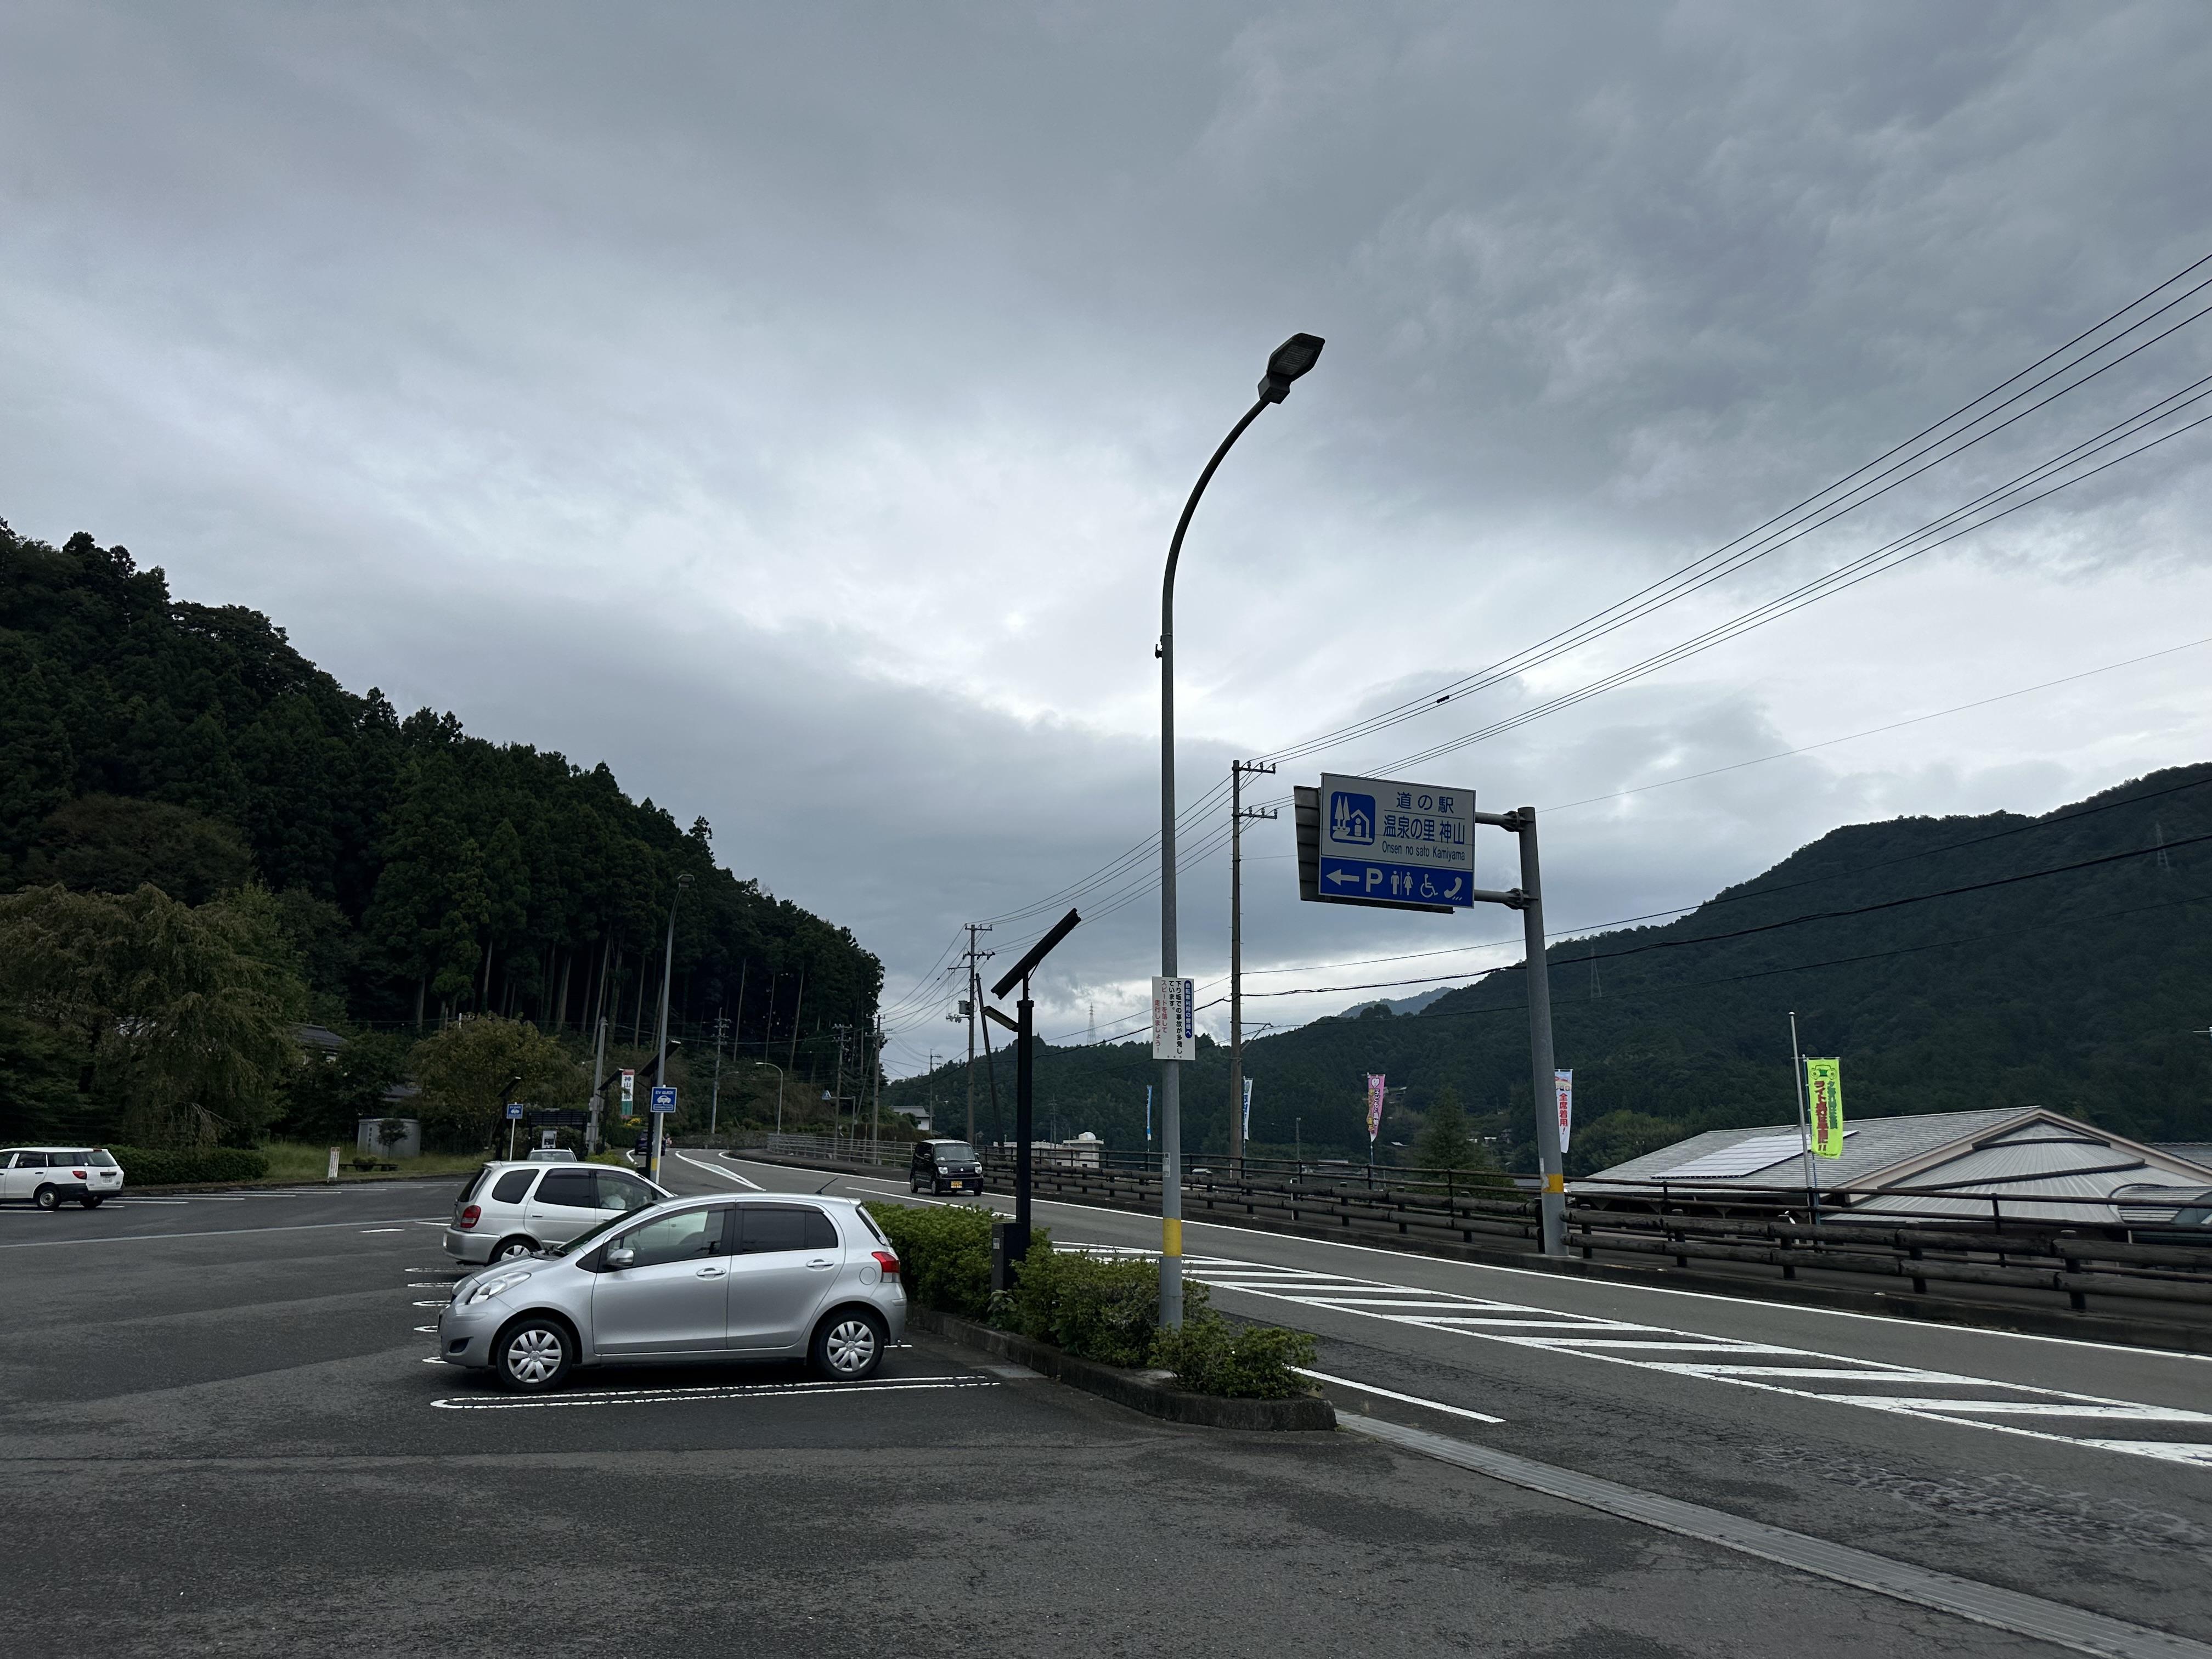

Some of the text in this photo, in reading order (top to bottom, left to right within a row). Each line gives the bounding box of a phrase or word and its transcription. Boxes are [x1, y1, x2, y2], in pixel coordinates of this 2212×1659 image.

[1396, 792, 1454, 814] 道の駅
[1382, 840, 1465, 862] Onsen no sato Kamiyama
[1366, 868, 1383, 892] P
